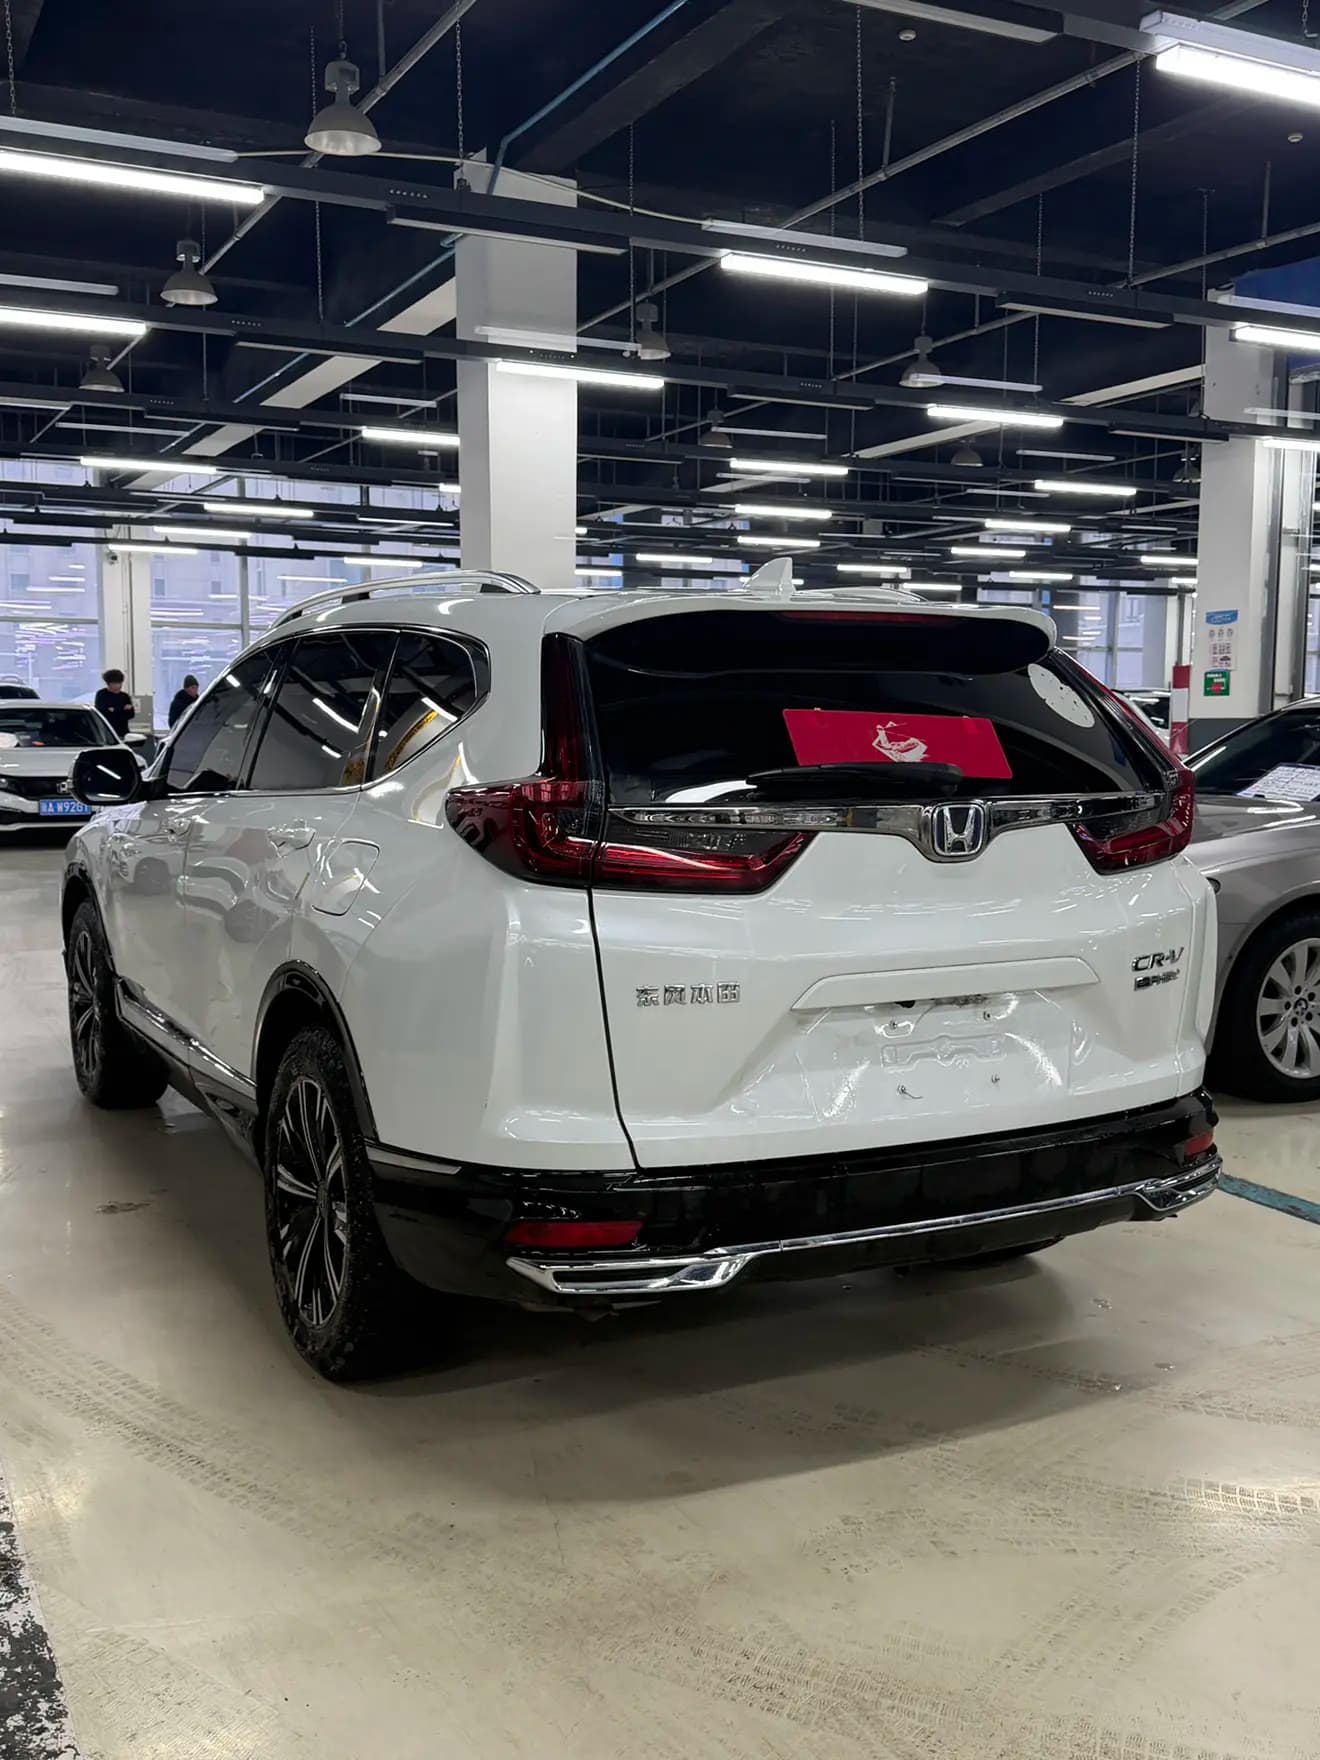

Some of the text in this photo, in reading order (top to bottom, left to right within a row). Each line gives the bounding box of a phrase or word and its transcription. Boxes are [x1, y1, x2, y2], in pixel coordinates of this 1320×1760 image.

[943, 806, 976, 854] H
[1131, 946, 1185, 972] CR-V
[635, 981, 741, 1007] 东风本田
